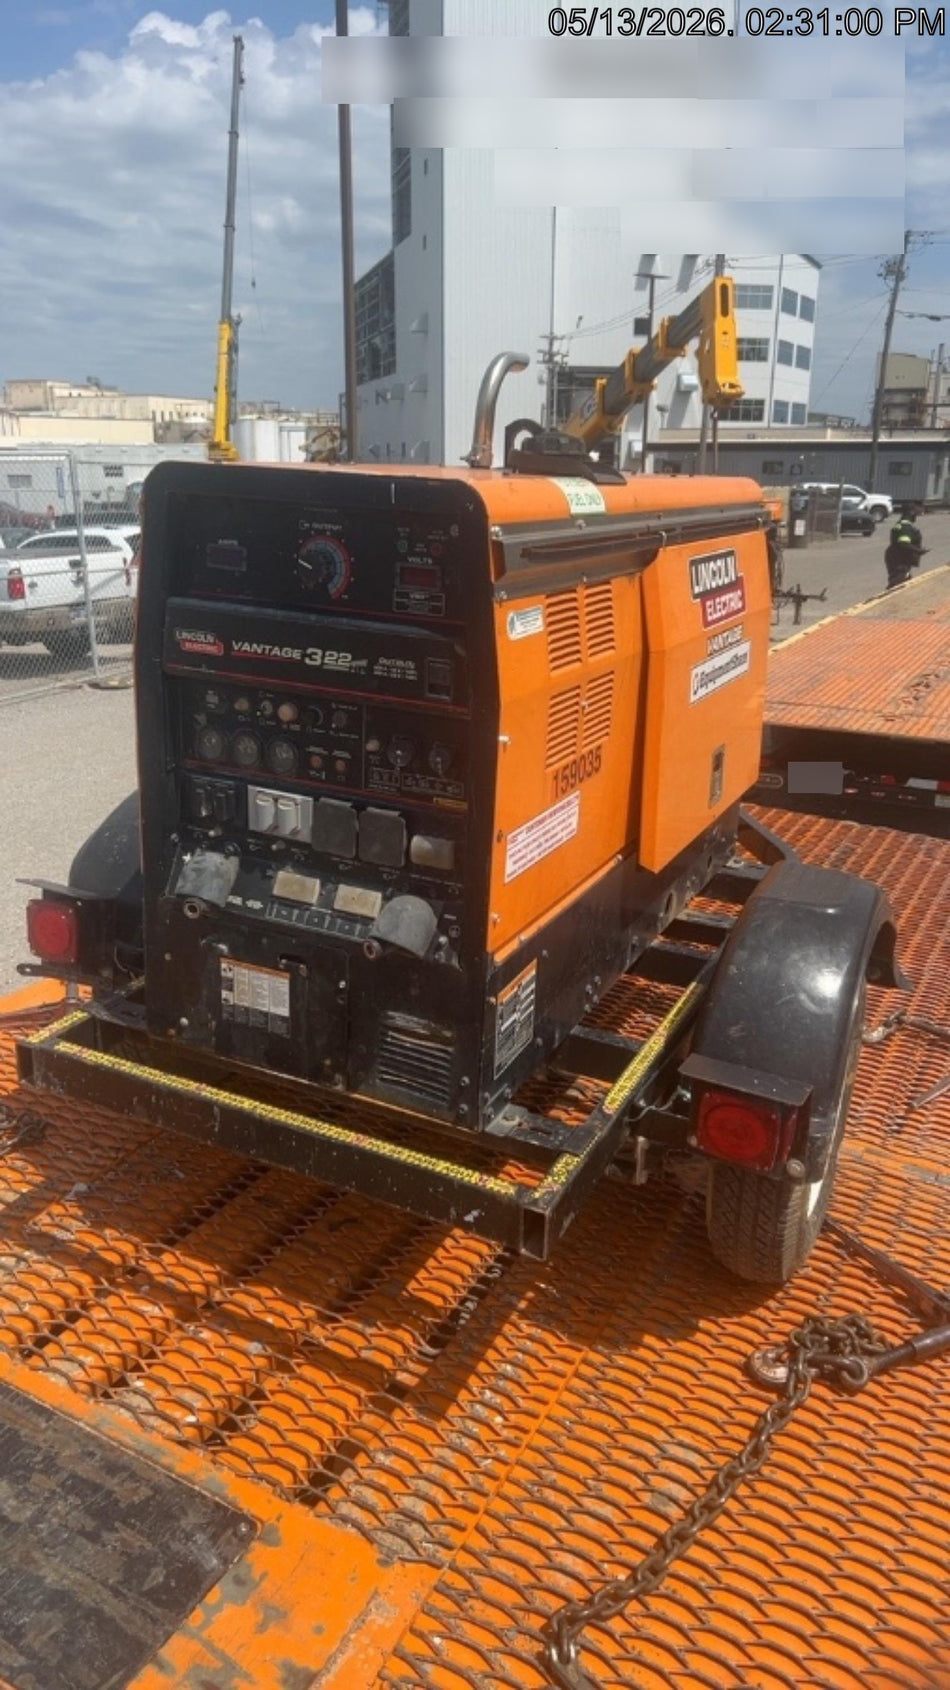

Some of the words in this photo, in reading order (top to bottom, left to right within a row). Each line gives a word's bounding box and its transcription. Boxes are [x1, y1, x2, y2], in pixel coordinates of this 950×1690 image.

[407, 555, 433, 564] VOLTS
[692, 555, 737, 594] LINCOLN
[705, 589, 743, 623] ELECTRIC
[175, 630, 215, 643] LINCOLN
[705, 624, 743, 656] VANTAGE
[232, 640, 302, 660] VANTAGE
[304, 647, 352, 666] 322
[552, 745, 602, 798] 159035
